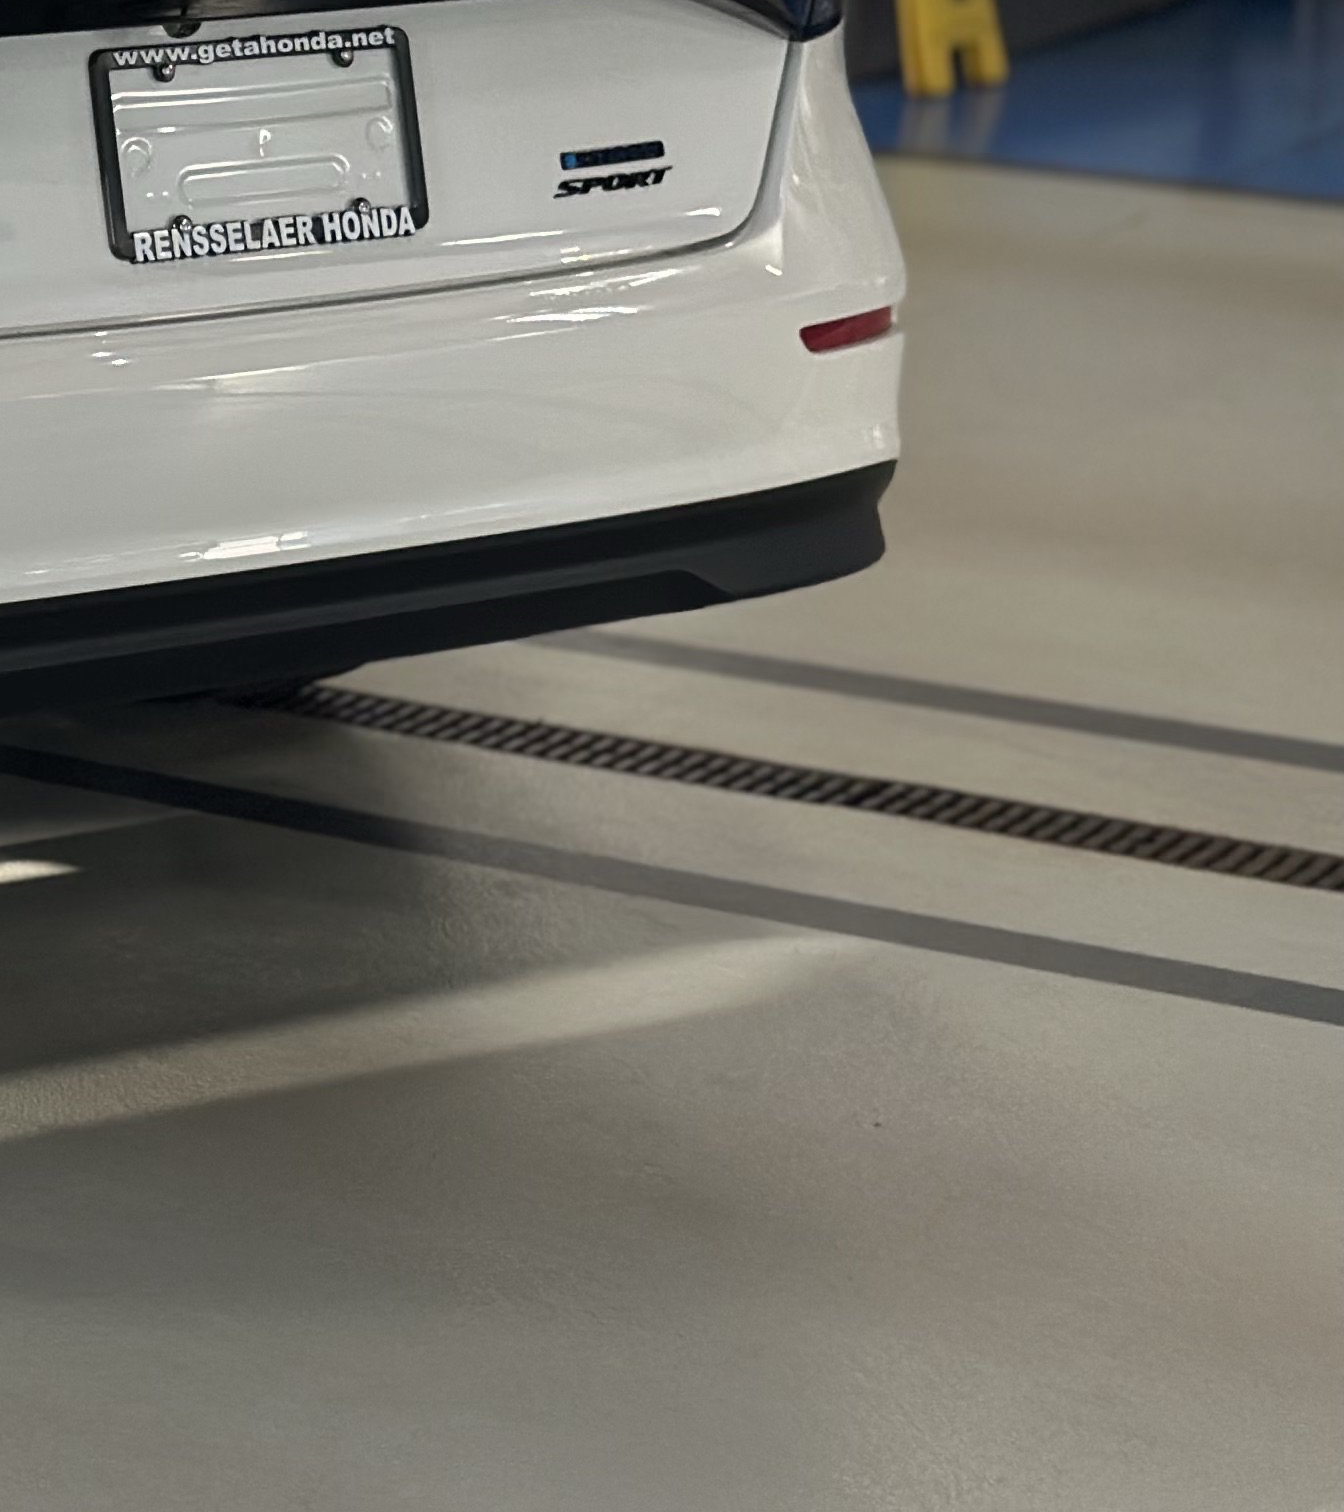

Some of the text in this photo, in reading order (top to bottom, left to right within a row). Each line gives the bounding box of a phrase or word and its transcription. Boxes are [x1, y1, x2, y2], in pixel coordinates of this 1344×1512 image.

[113, 27, 395, 65] www.getahonda.net
[553, 165, 673, 199] SPORT
[132, 206, 417, 263] RENSSELAER HONDA
